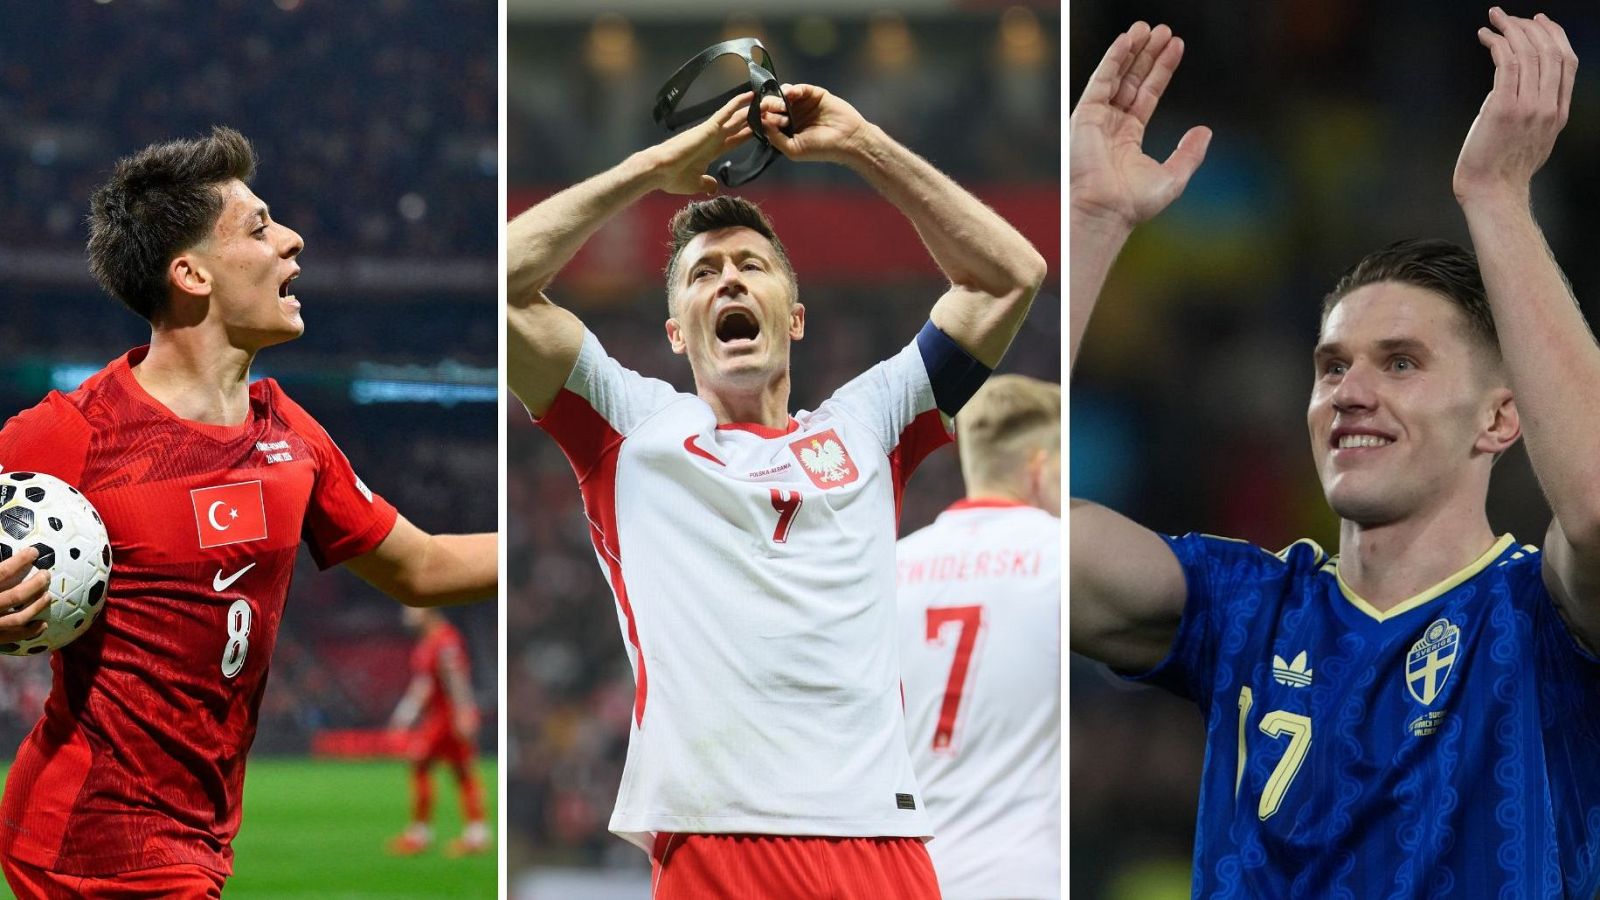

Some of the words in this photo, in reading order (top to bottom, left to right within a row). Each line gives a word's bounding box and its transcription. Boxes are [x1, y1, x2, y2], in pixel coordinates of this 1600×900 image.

[769, 486, 804, 544] 9
[220, 599, 252, 679] 8
[1415, 636, 1452, 659] SVERIGE
[926, 604, 986, 755] 7
[1236, 685, 1313, 822] 17
